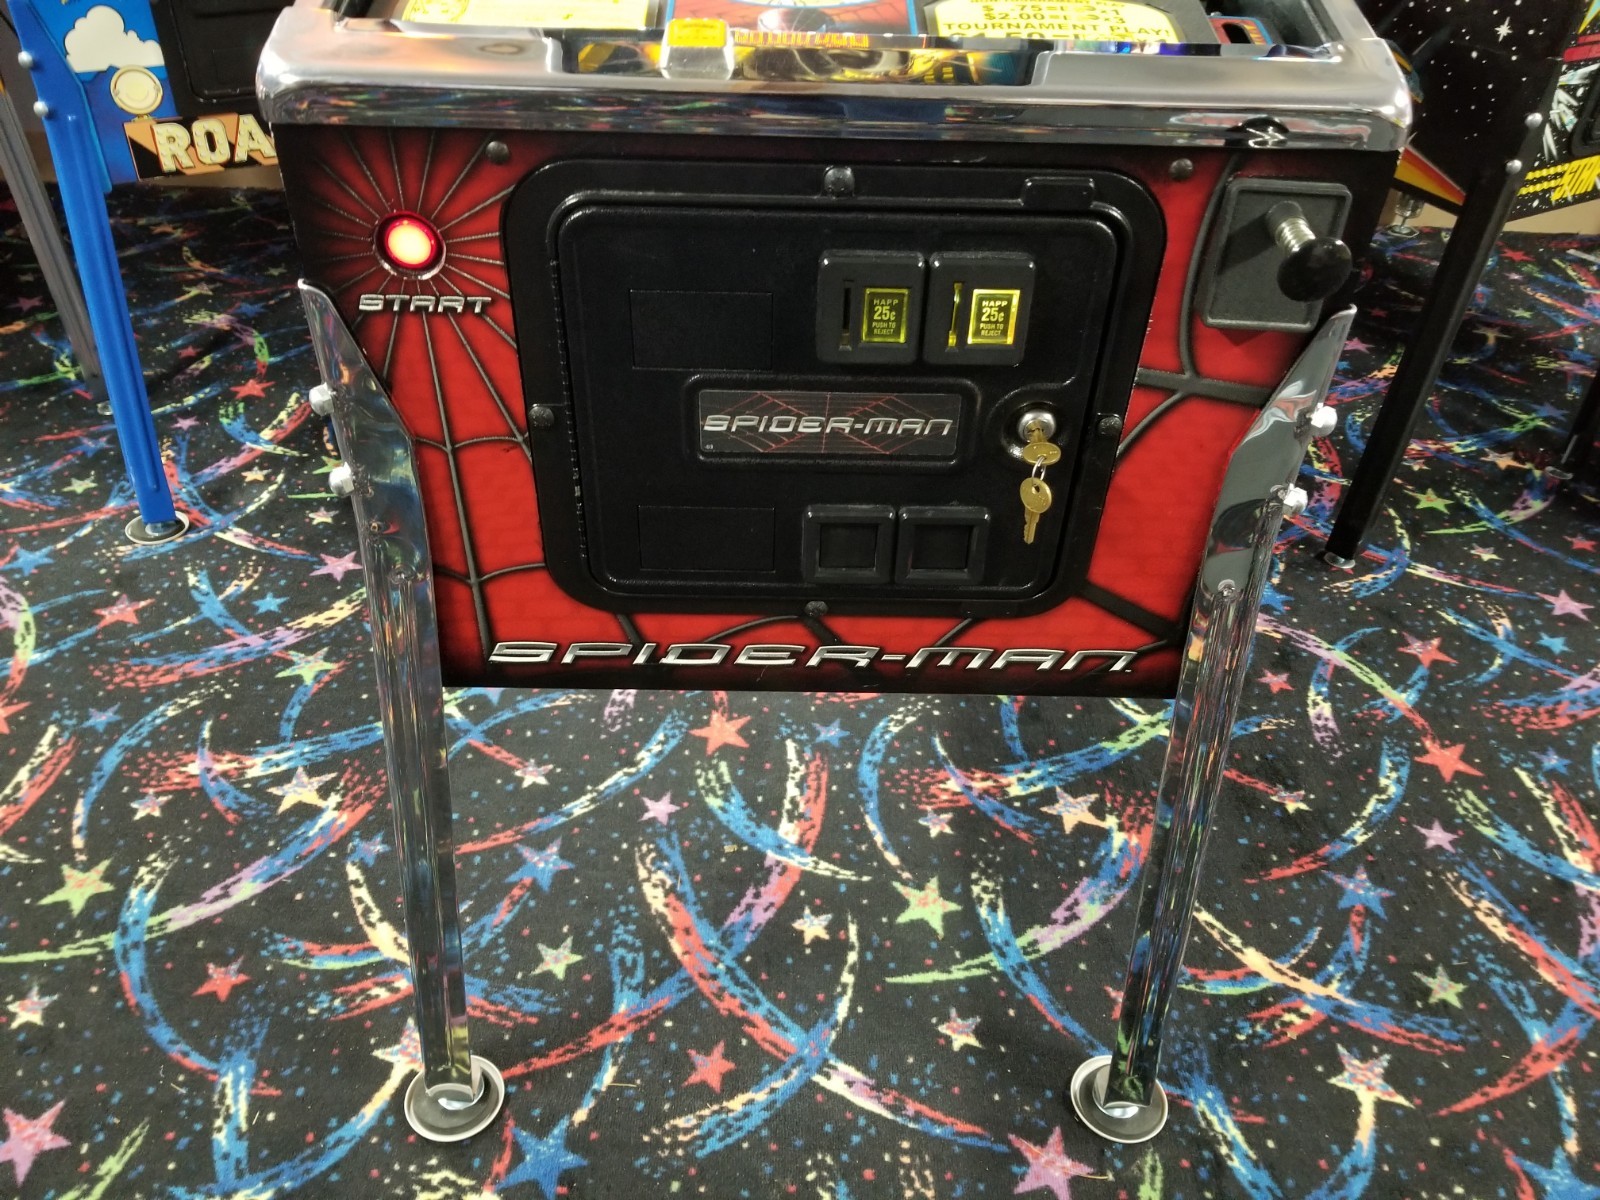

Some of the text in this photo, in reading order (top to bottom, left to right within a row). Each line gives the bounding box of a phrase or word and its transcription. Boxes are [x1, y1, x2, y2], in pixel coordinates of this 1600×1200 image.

[943, 22, 1099, 32] TOURNAMENT
[358, 294, 492, 313] START
[703, 414, 954, 436] SPIDER-MAN
[488, 640, 1138, 672] SPIDER-MAN
